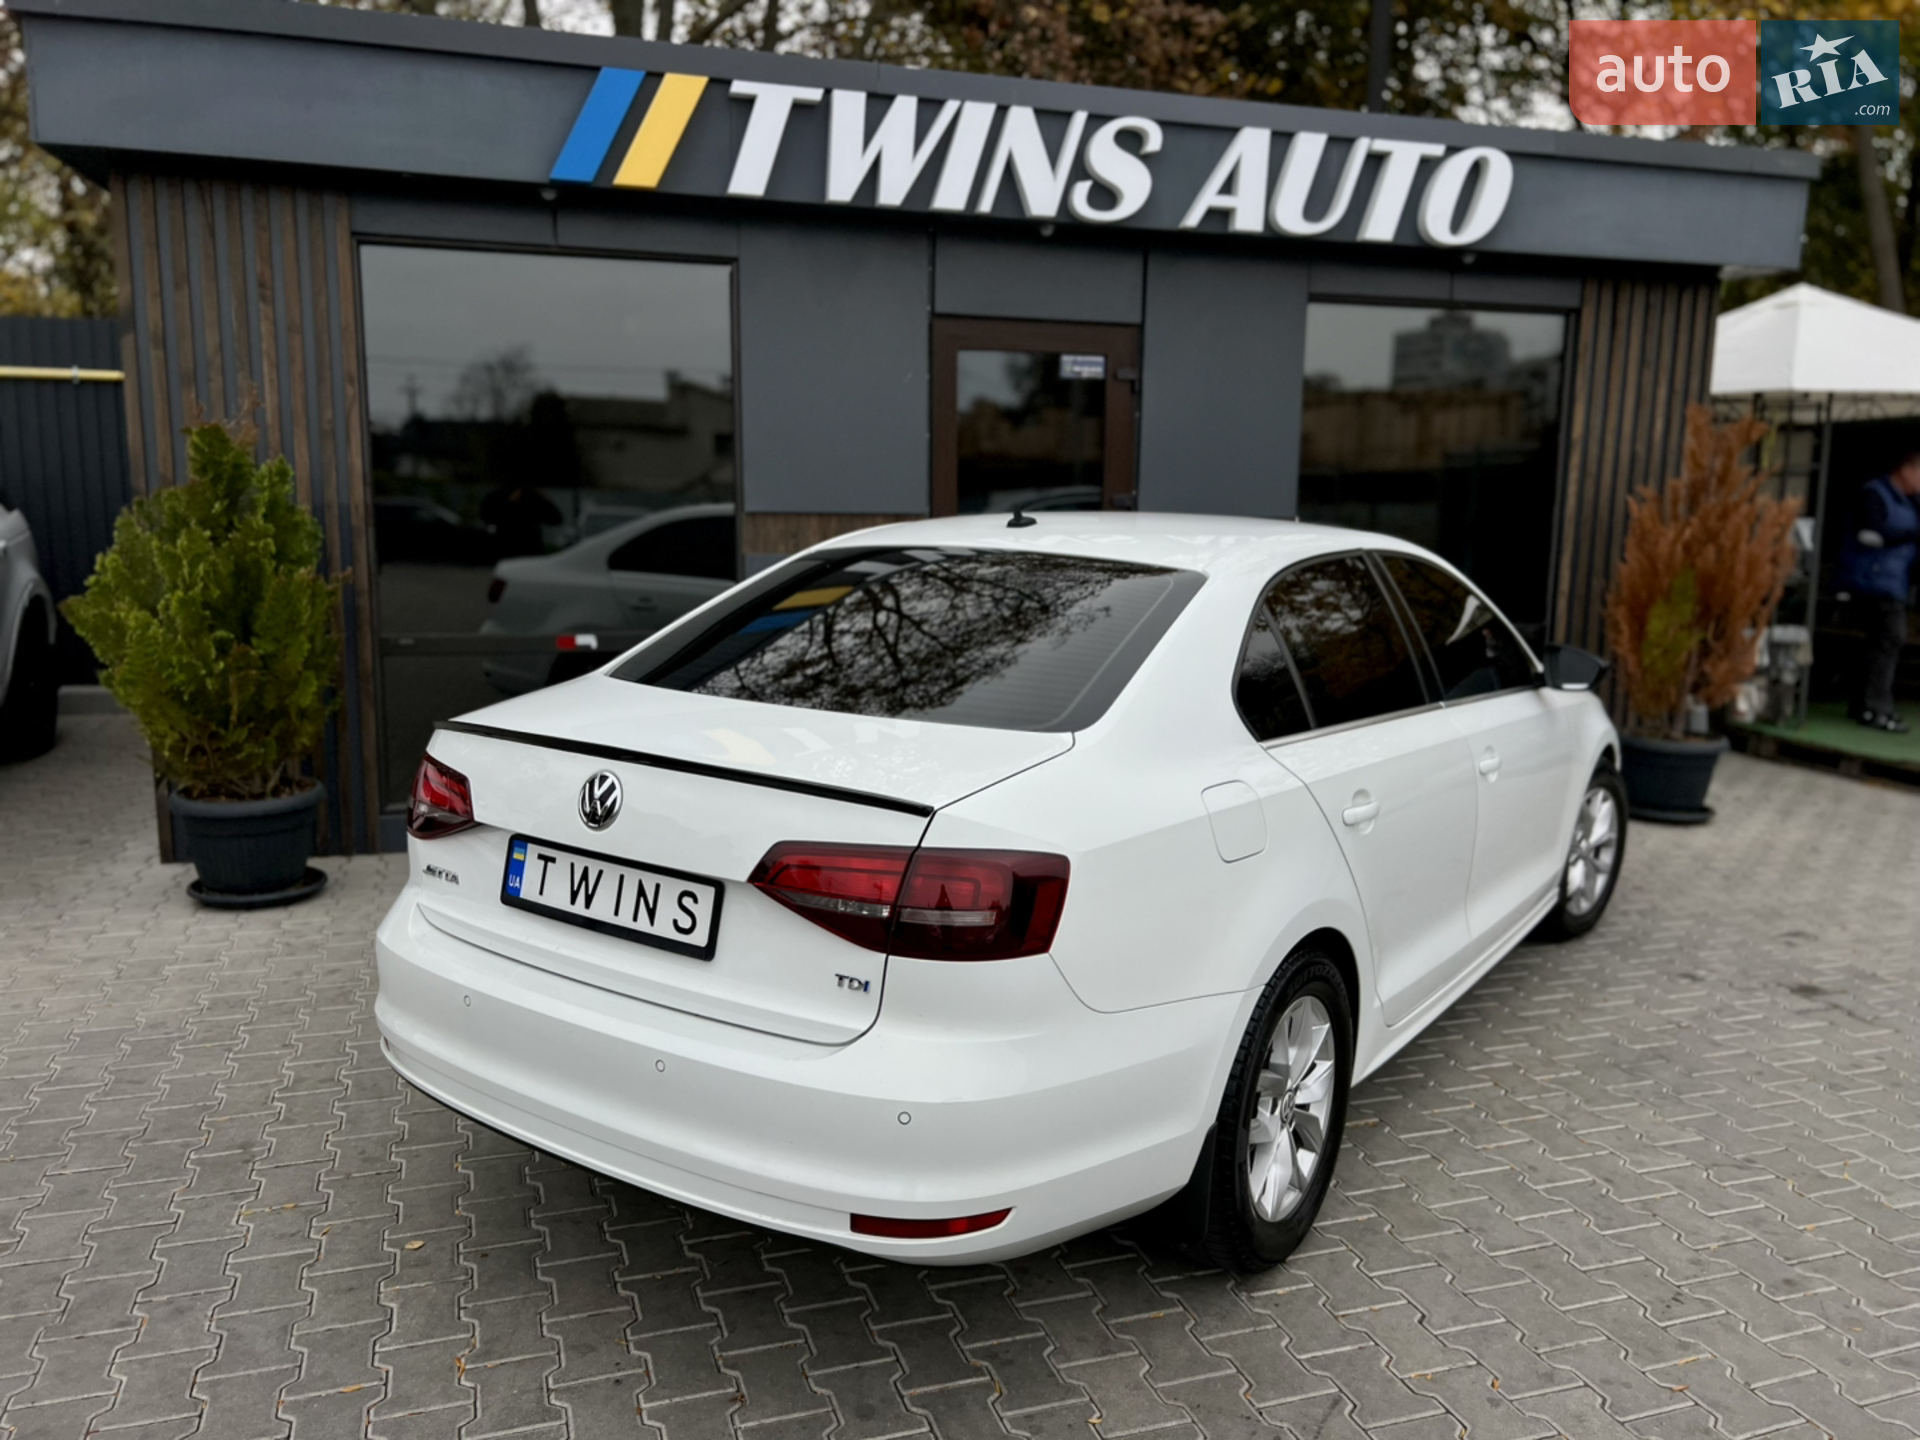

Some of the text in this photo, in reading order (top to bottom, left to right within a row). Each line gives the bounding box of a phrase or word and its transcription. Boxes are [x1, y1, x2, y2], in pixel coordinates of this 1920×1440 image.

[726, 79, 1515, 248] TWINS AUTO
[508, 873, 521, 889] UA
[834, 972, 870, 993] TDI
